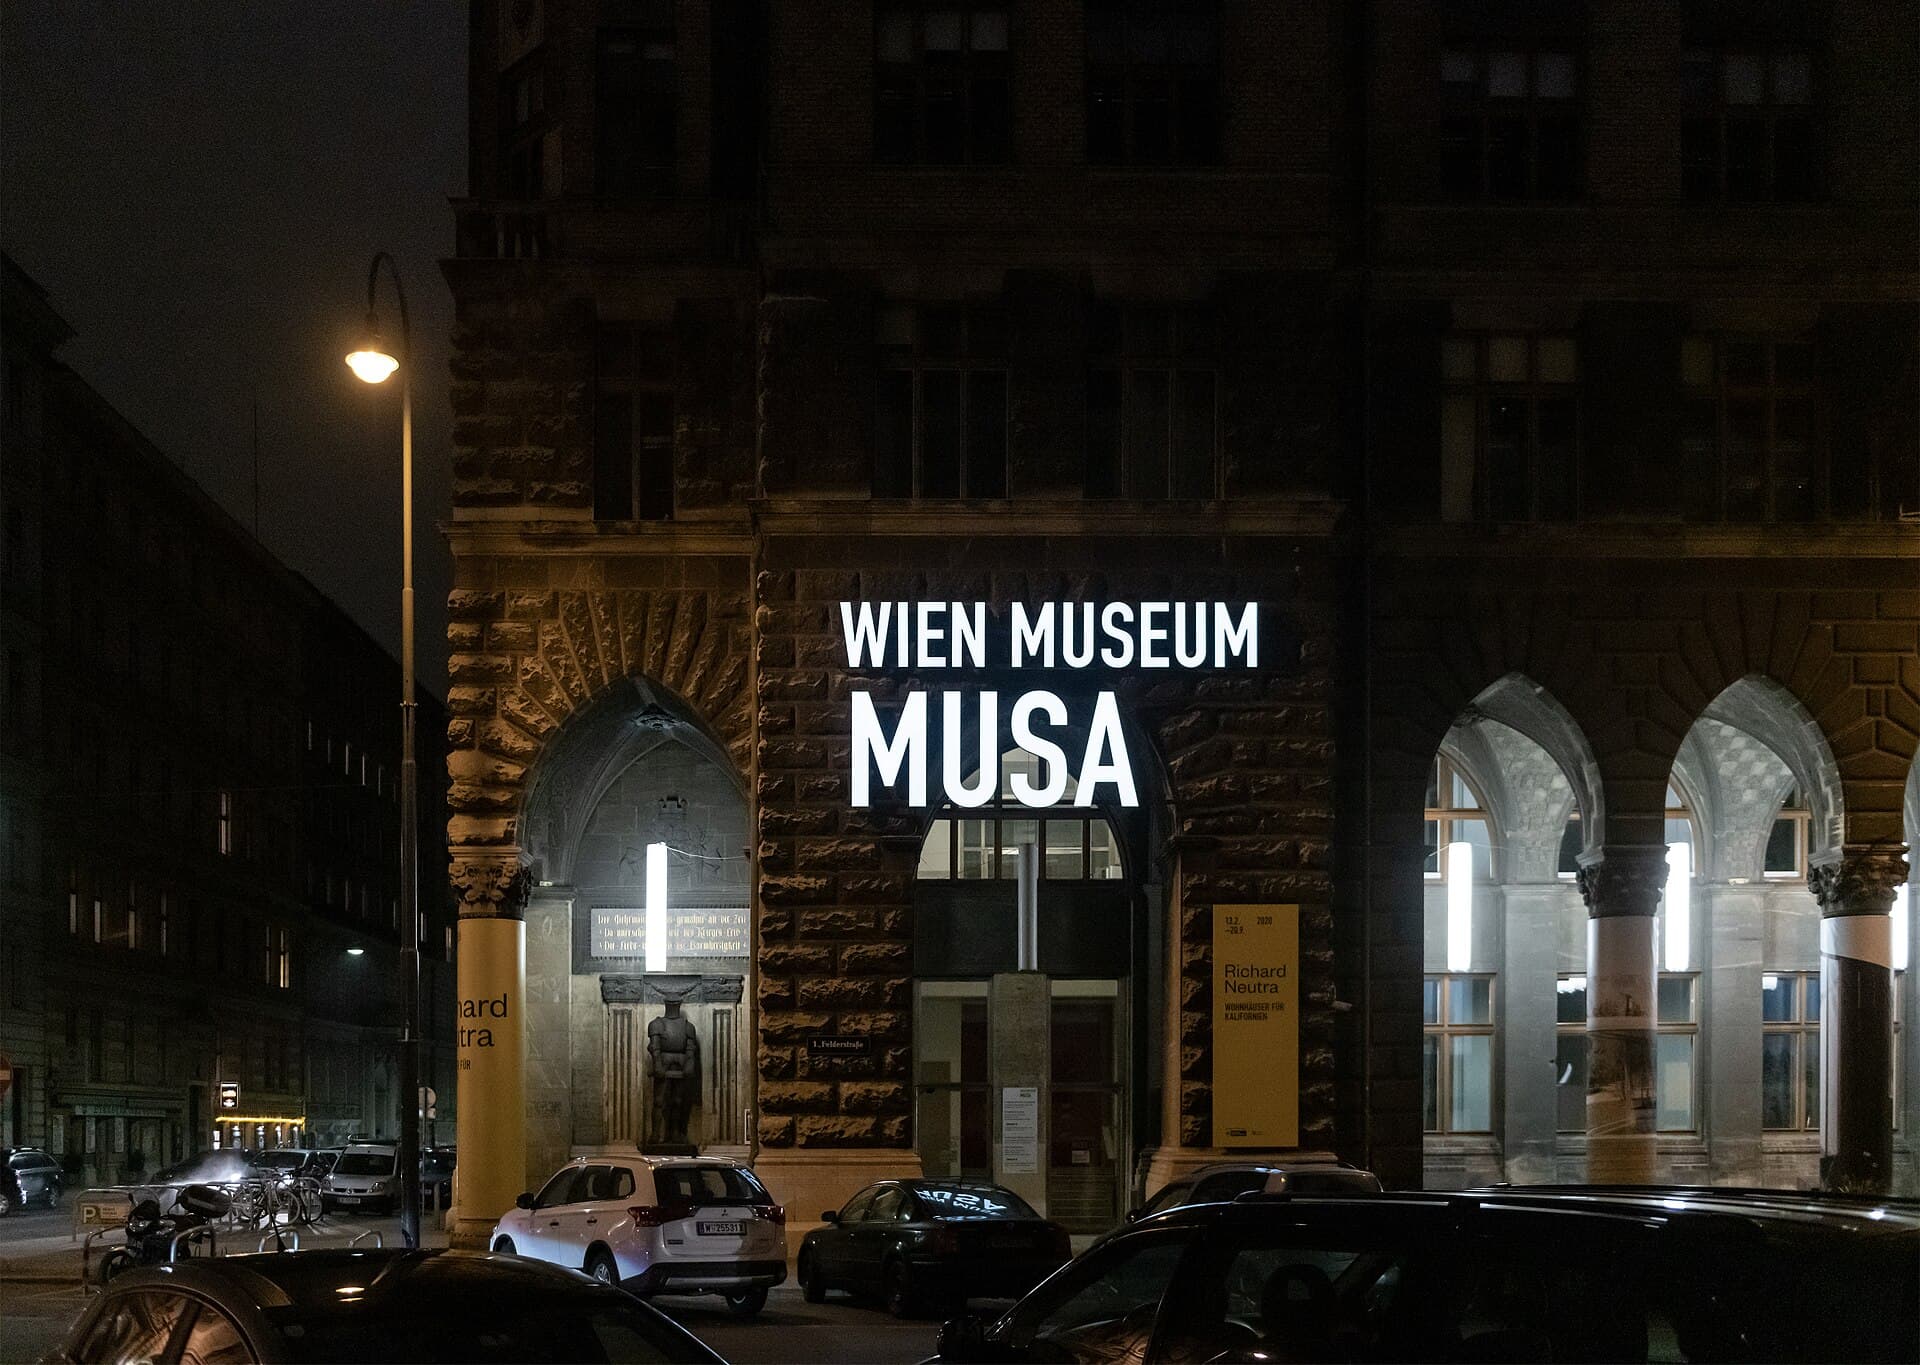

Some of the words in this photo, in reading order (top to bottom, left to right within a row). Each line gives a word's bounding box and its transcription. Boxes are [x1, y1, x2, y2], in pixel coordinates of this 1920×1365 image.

[839, 601, 987, 668] WIEN
[1011, 601, 1259, 668] MUSEUM
[850, 690, 1140, 808] MUSA
[1225, 964, 1287, 978] Richard
[1225, 980, 1279, 994] Neutra
[457, 1026, 495, 1047] tra
[83, 1206, 96, 1224] P
